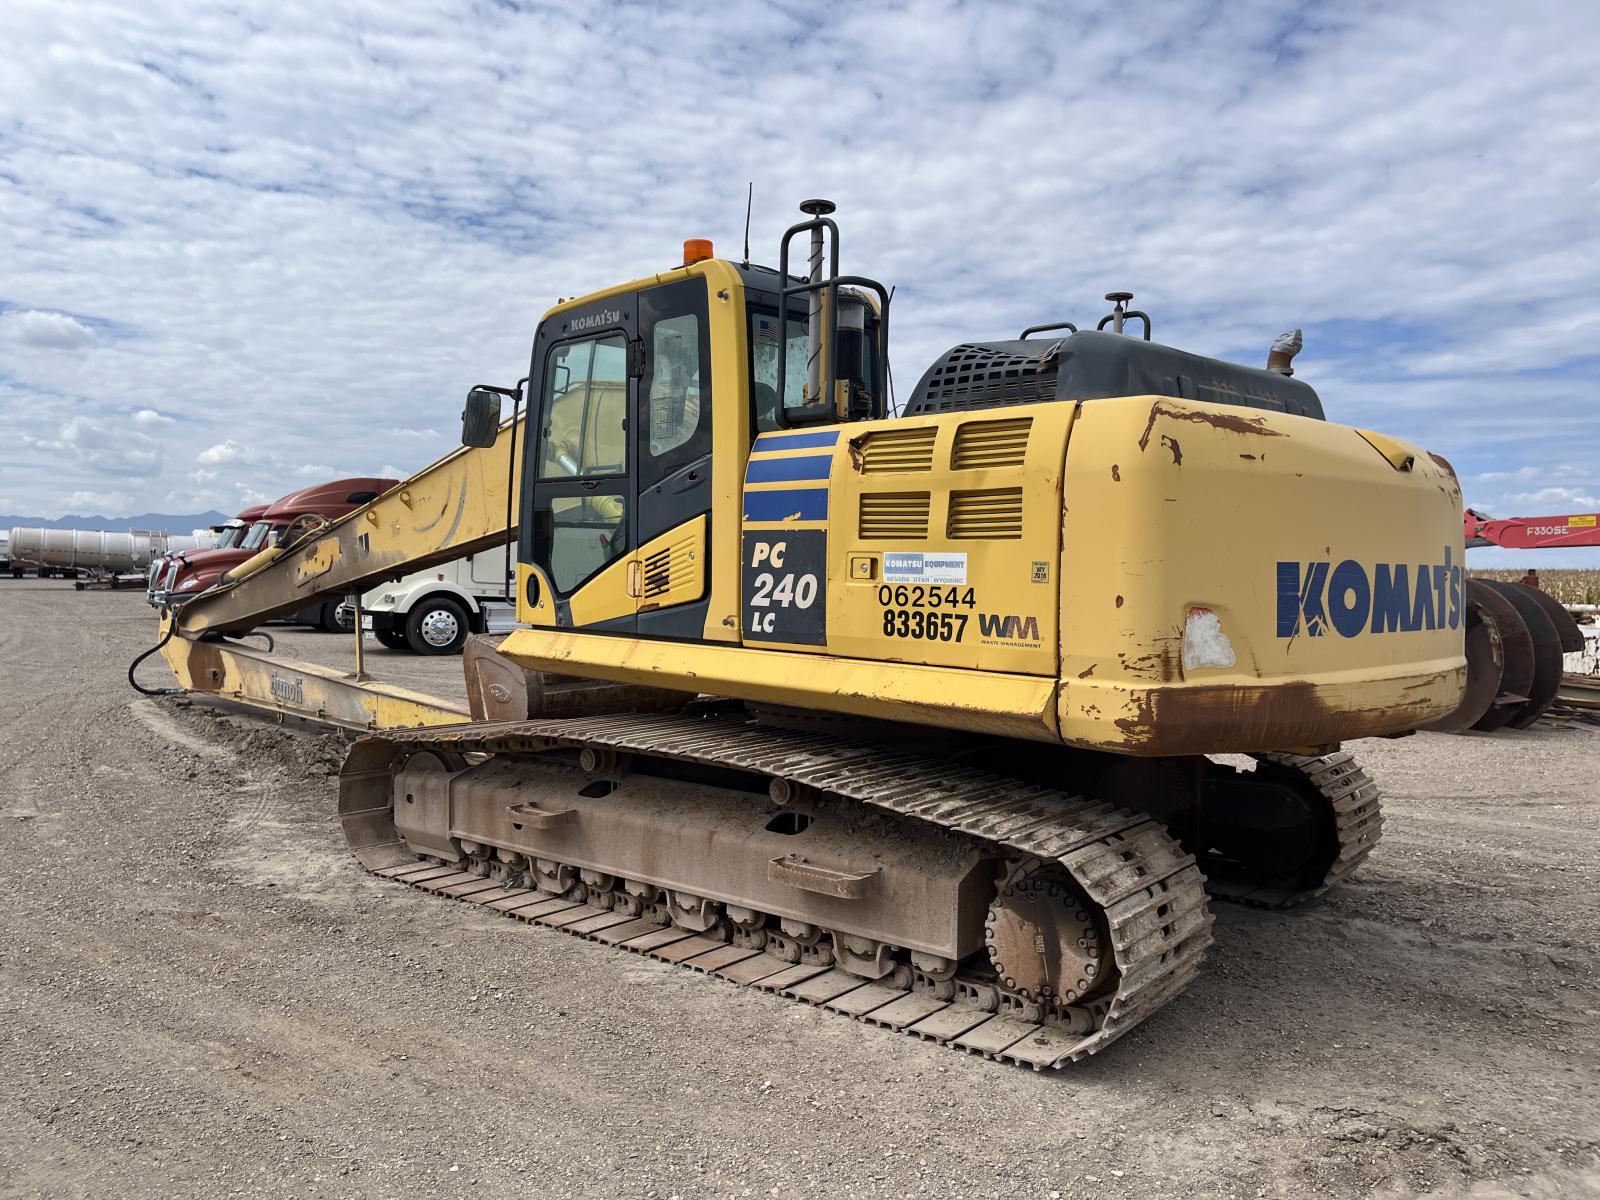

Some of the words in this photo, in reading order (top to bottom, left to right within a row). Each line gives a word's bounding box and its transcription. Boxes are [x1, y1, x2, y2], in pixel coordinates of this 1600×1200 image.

[571, 309, 620, 331] KOMATSU
[1526, 525, 1569, 536] F330SE
[751, 541, 787, 569] PC
[885, 559, 923, 568] KOMATSU
[924, 560, 965, 569] EQUIPMENT
[750, 572, 818, 609] 240
[878, 585, 976, 609] 062544
[751, 611, 776, 633] LC
[883, 609, 969, 643] 833657
[978, 613, 1040, 640] WM
[1000, 641, 1041, 649] MANAGEMENT
